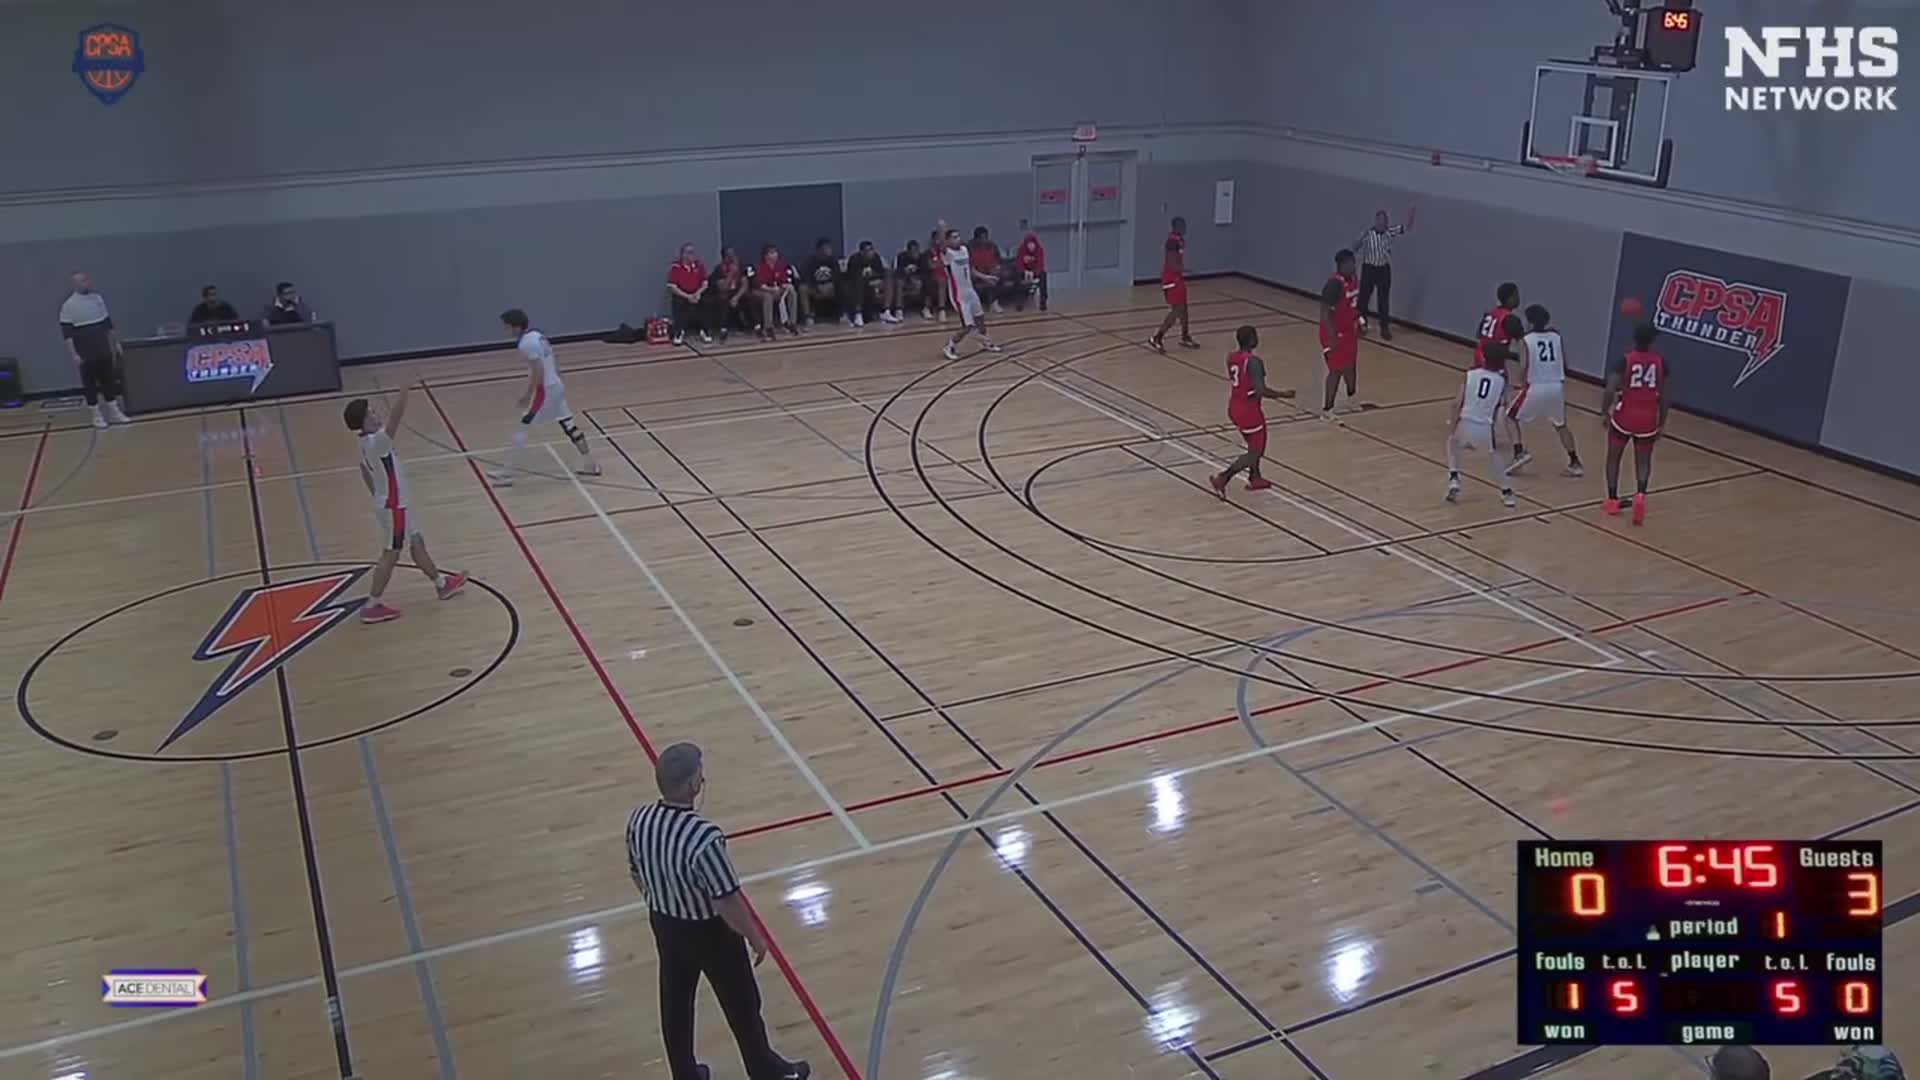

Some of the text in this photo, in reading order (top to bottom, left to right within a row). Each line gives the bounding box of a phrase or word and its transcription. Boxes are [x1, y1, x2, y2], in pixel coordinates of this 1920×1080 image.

[1481, 315, 1497, 338] 21
[1662, 275, 1781, 360] CPSA
[1659, 312, 1757, 349] THUNDER
[1538, 341, 1555, 362] 21
[1231, 365, 1239, 387] 3
[1630, 363, 1656, 388] 24
[1478, 378, 1491, 399] 0
